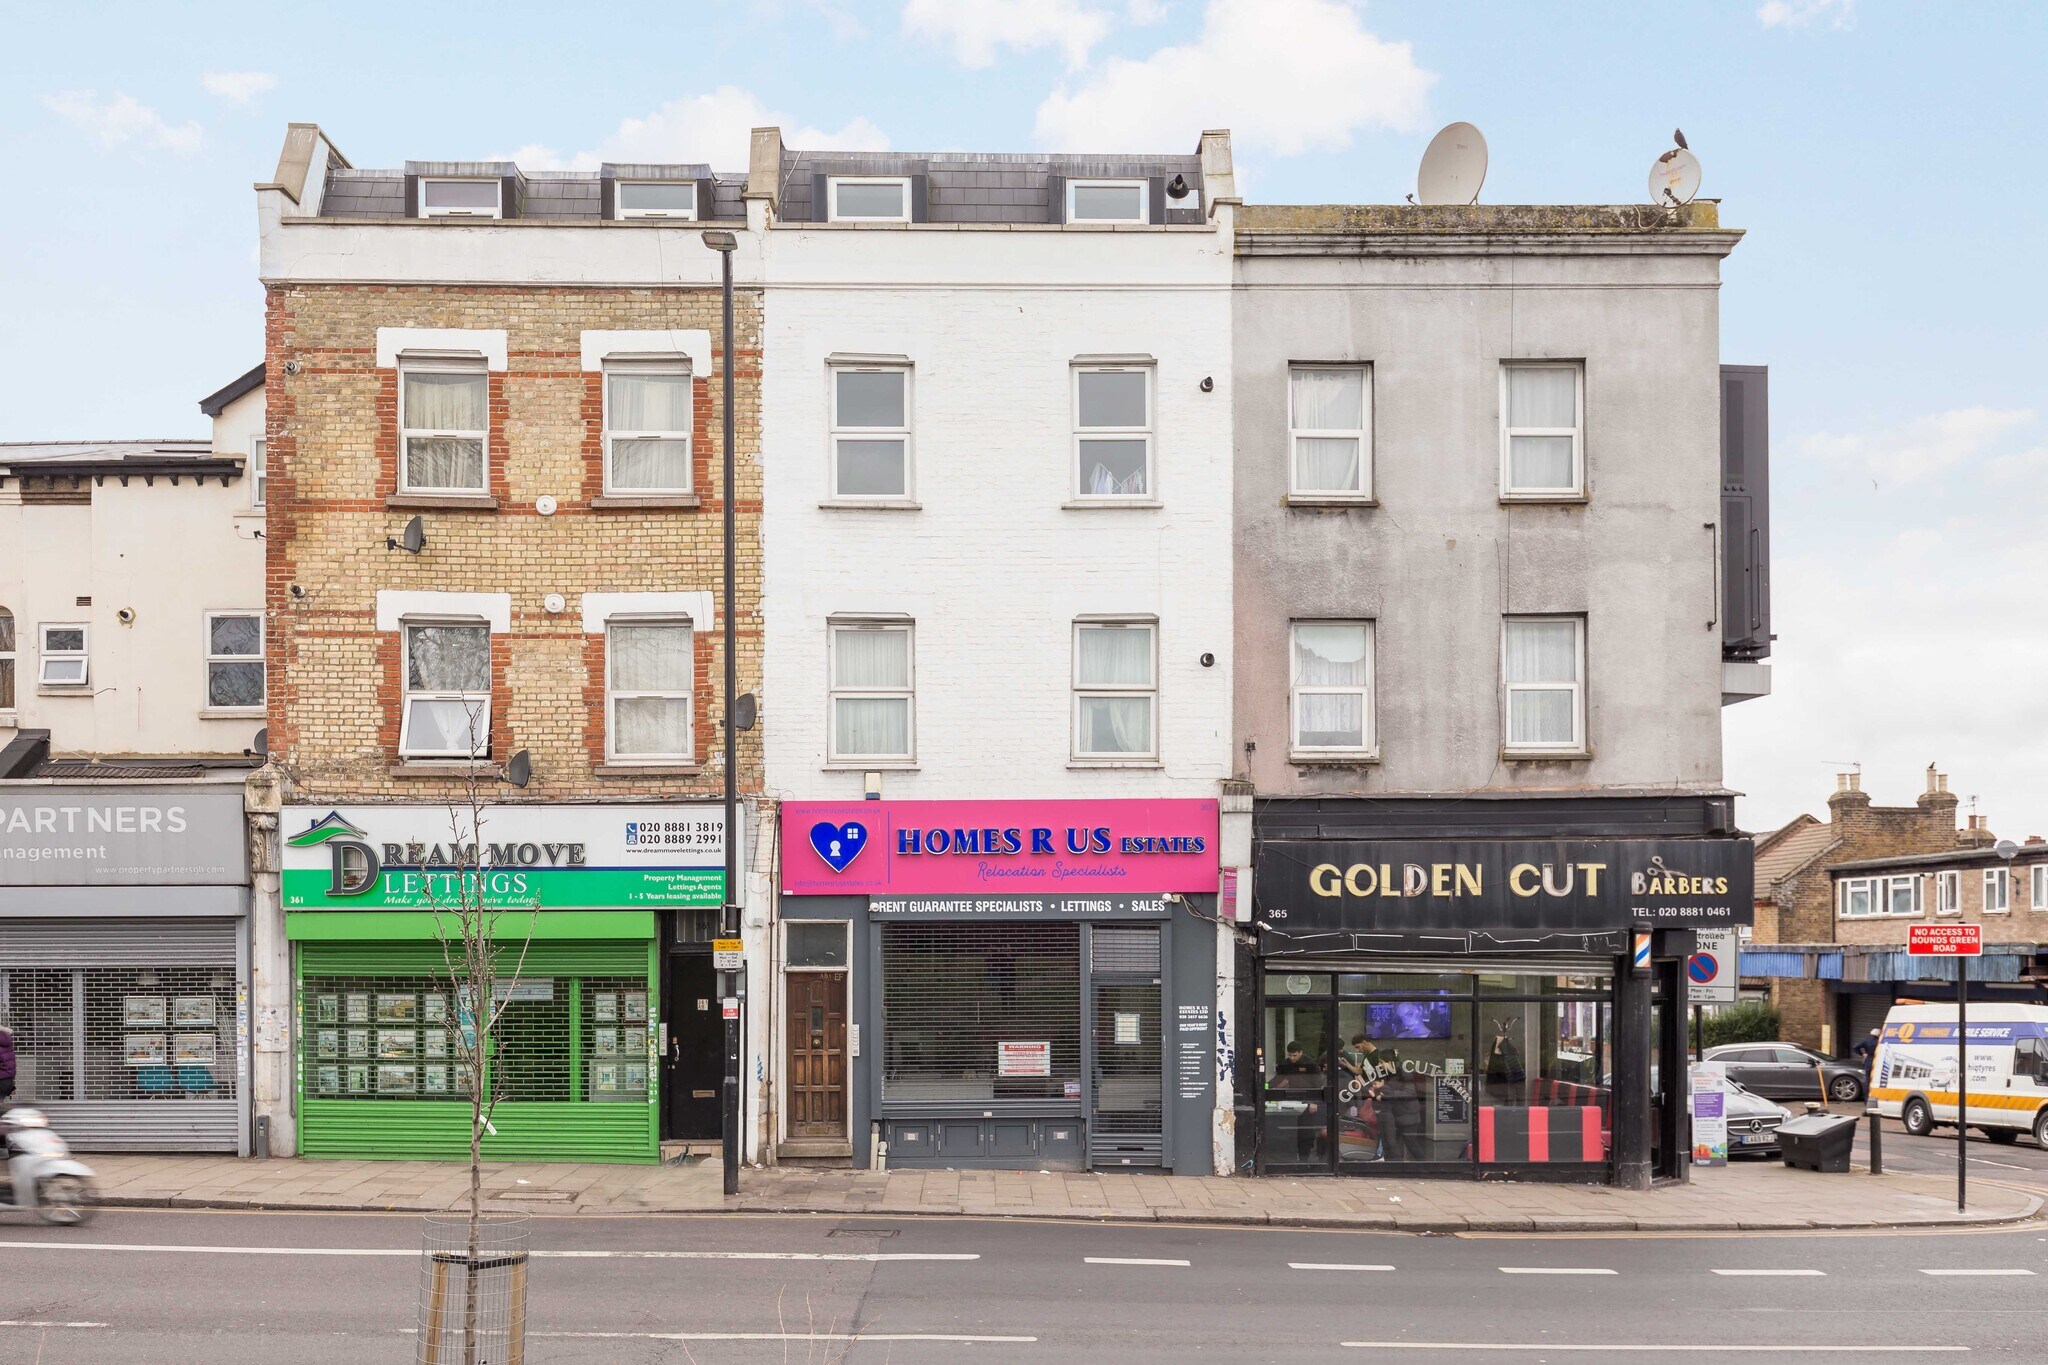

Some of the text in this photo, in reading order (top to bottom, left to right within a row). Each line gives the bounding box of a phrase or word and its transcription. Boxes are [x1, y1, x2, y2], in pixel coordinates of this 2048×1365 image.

[0, 806, 187, 834] ARTNERS
[640, 822, 723, 832] 020 8881 3819
[640, 834, 721, 844] 020 8889 2991
[896, 827, 1206, 855] HOMES R US ESTATES
[0, 845, 107, 861] nagement
[488, 843, 587, 866] MOVE
[977, 861, 1127, 881] Relocation Specialists
[644, 874, 722, 882] Property Management
[1309, 863, 1728, 897] GOLDEN CUT BARBERS
[384, 873, 528, 894] LETTINGS
[668, 884, 696, 892] Lettings
[290, 896, 304, 904] 361
[384, 896, 411, 904] Make
[666, 892, 691, 900] leasing
[879, 900, 1165, 912] RENT GUARANTEE SPECIALISTS LETTINGS SALES
[1268, 909, 1288, 919] 365
[1632, 907, 1731, 917] TEL: 020 8881 0461
[1914, 928, 1975, 936] NO ACCESS TO
[1911, 936, 1978, 944] BOUNDS GREEN
[1696, 942, 1718, 950] ONE
[1933, 944, 1957, 952] ROAD
[1952, 1027, 1979, 1037] MBILE
[1979, 1027, 2011, 1037] SERVICE
[1967, 1063, 1996, 1074] hiqtyres
[1339, 1061, 1397, 1103] GOLDEN
[1402, 1059, 1441, 1078] CUT
[1443, 1074, 1473, 1104] BARBERS
